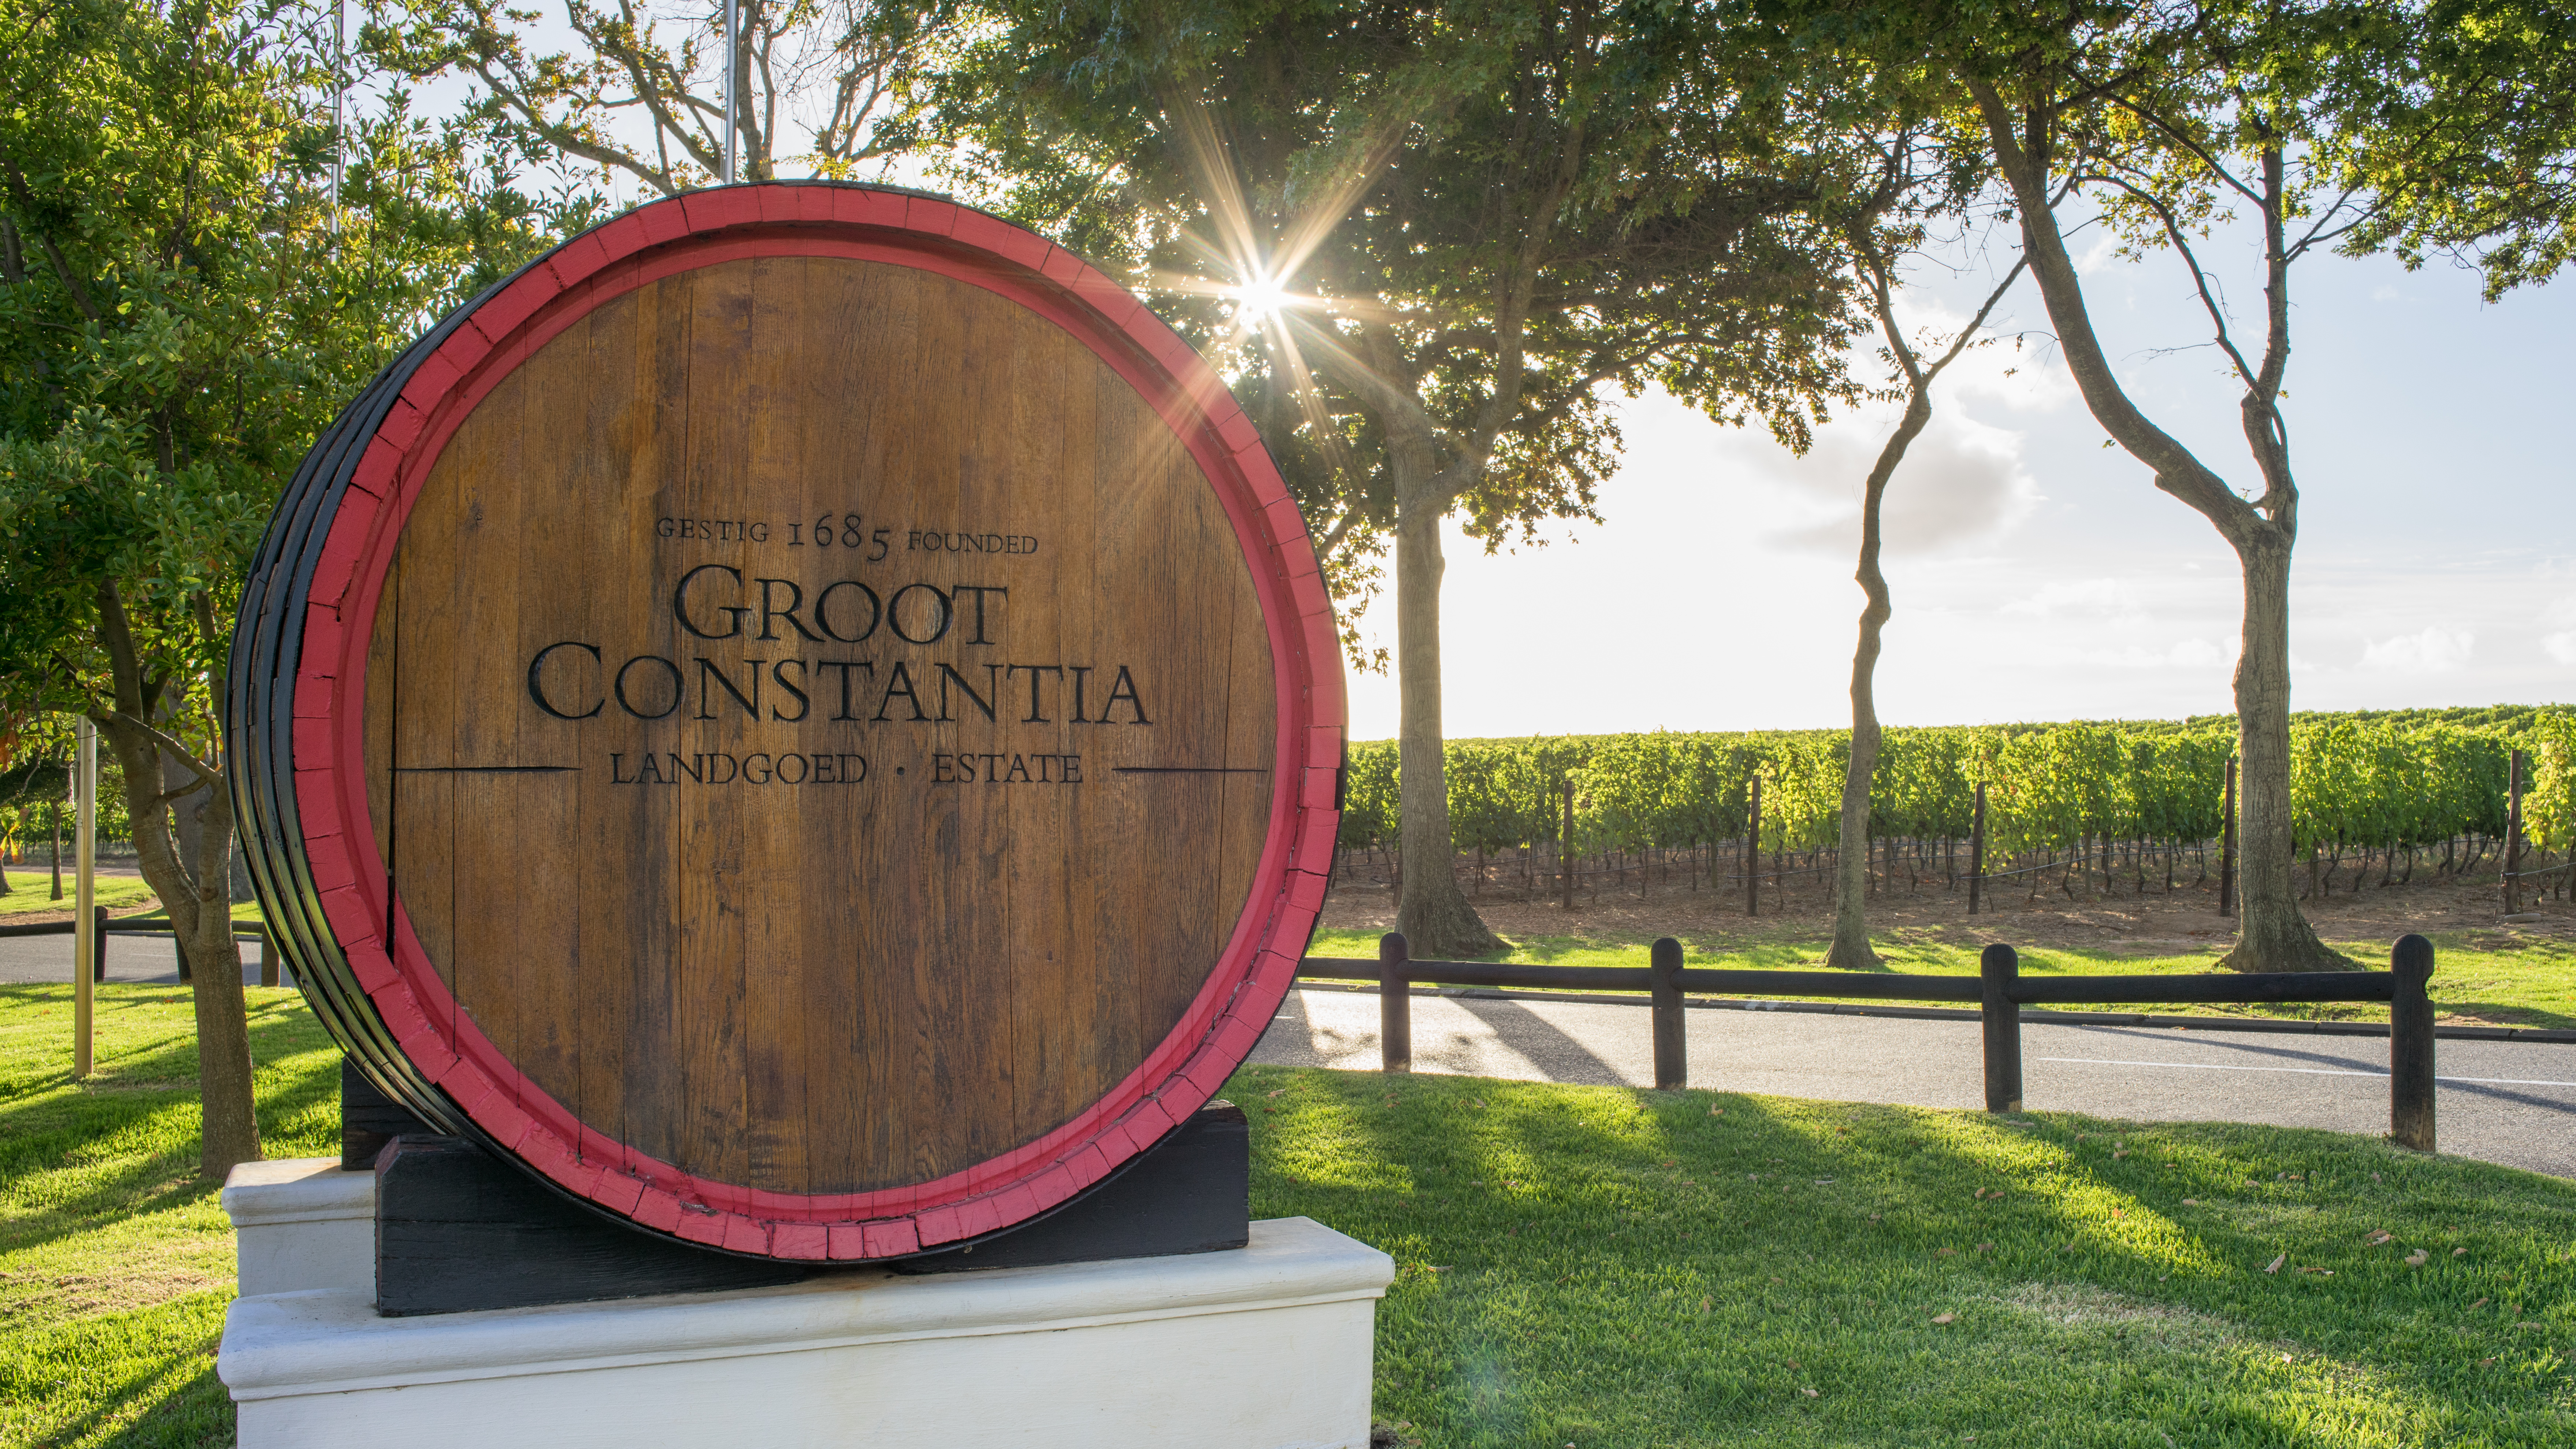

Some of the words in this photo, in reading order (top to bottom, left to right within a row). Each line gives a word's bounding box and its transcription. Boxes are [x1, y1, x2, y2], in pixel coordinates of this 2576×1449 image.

[656, 516, 769, 542] GESTIG
[788, 513, 891, 562] 1685
[908, 530, 1038, 554] FOUNDED
[673, 564, 1008, 645] GROOT
[527, 641, 1154, 725] CONSTANTIA
[609, 752, 867, 784] LANDGOED
[930, 753, 1083, 784] ESTATE
